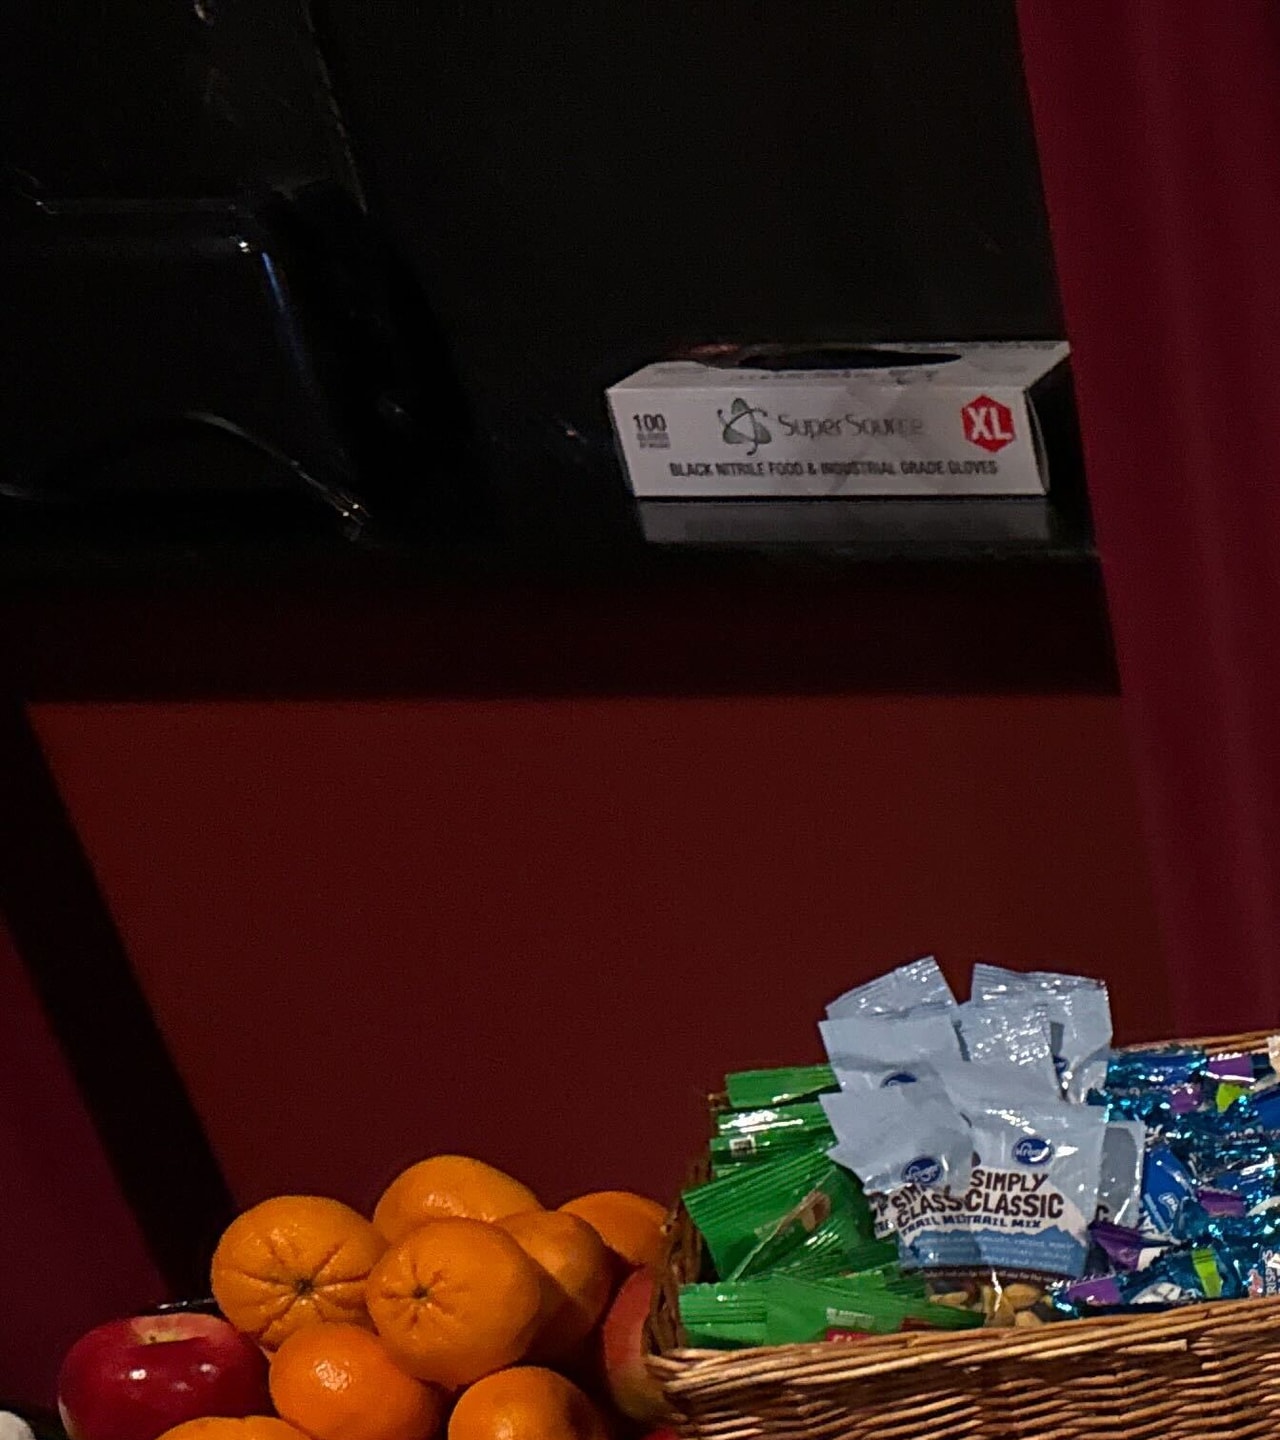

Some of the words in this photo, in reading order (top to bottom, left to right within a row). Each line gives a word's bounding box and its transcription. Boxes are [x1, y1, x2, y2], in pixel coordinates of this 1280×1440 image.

[633, 413, 668, 432] 100
[966, 407, 1013, 440] XL
[669, 462, 711, 477] BLACK
[714, 462, 765, 477] NITRILE
[767, 462, 803, 477] FOOD
[807, 462, 817, 476] &
[900, 460, 945, 476] GRADE
[949, 460, 999, 476] GLOVES
[970, 1169, 1049, 1192] SIMPLY
[897, 1194, 966, 1228] CLASS
[965, 1188, 1065, 1218] CLASSIC
[965, 1214, 1006, 1228] TRAIL
[1011, 1219, 1042, 1229] MIX
